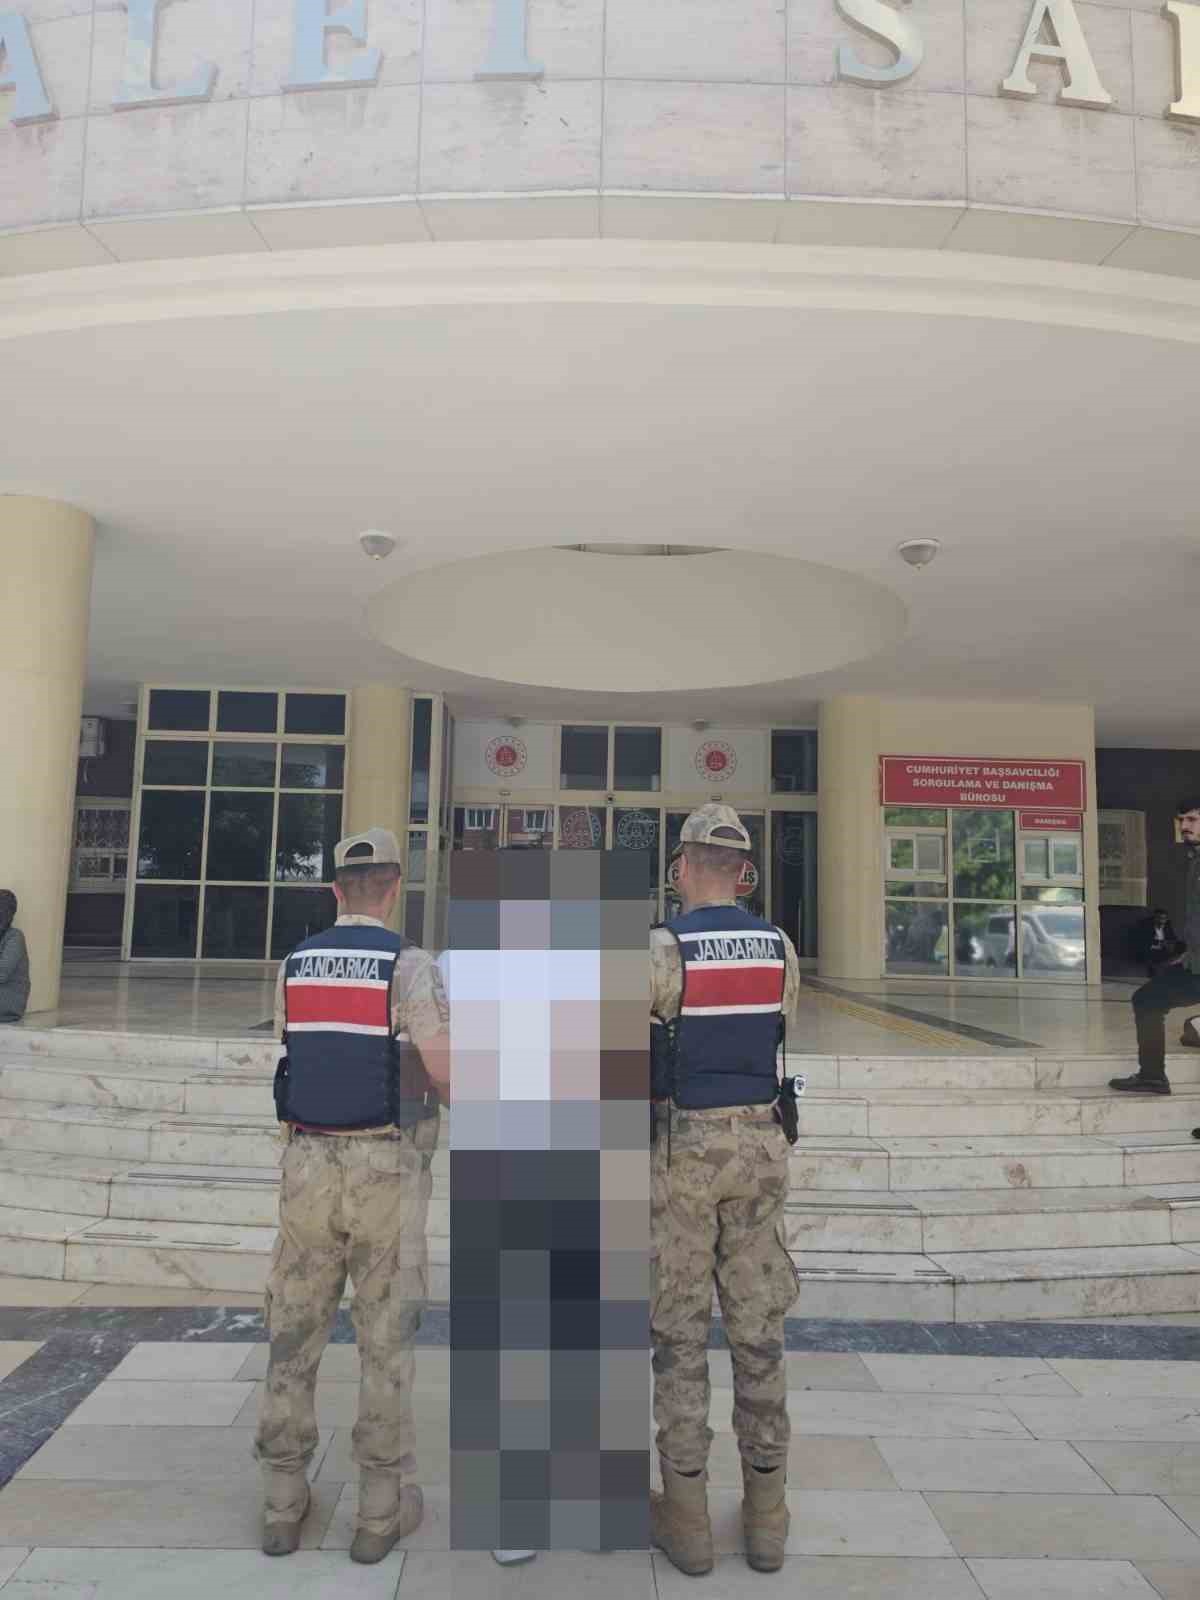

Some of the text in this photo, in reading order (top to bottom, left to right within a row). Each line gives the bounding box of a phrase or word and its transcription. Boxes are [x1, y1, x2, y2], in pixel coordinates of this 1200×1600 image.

[906, 764, 1060, 778] CUMHURİYET BAŞSAVCILIĞI
[913, 779, 1054, 792] SORGULAMA VE DANIŞMA
[960, 793, 1006, 802] BÜROSU
[694, 938, 777, 960] JANDARMA
[296, 956, 379, 979] JANDARMA
